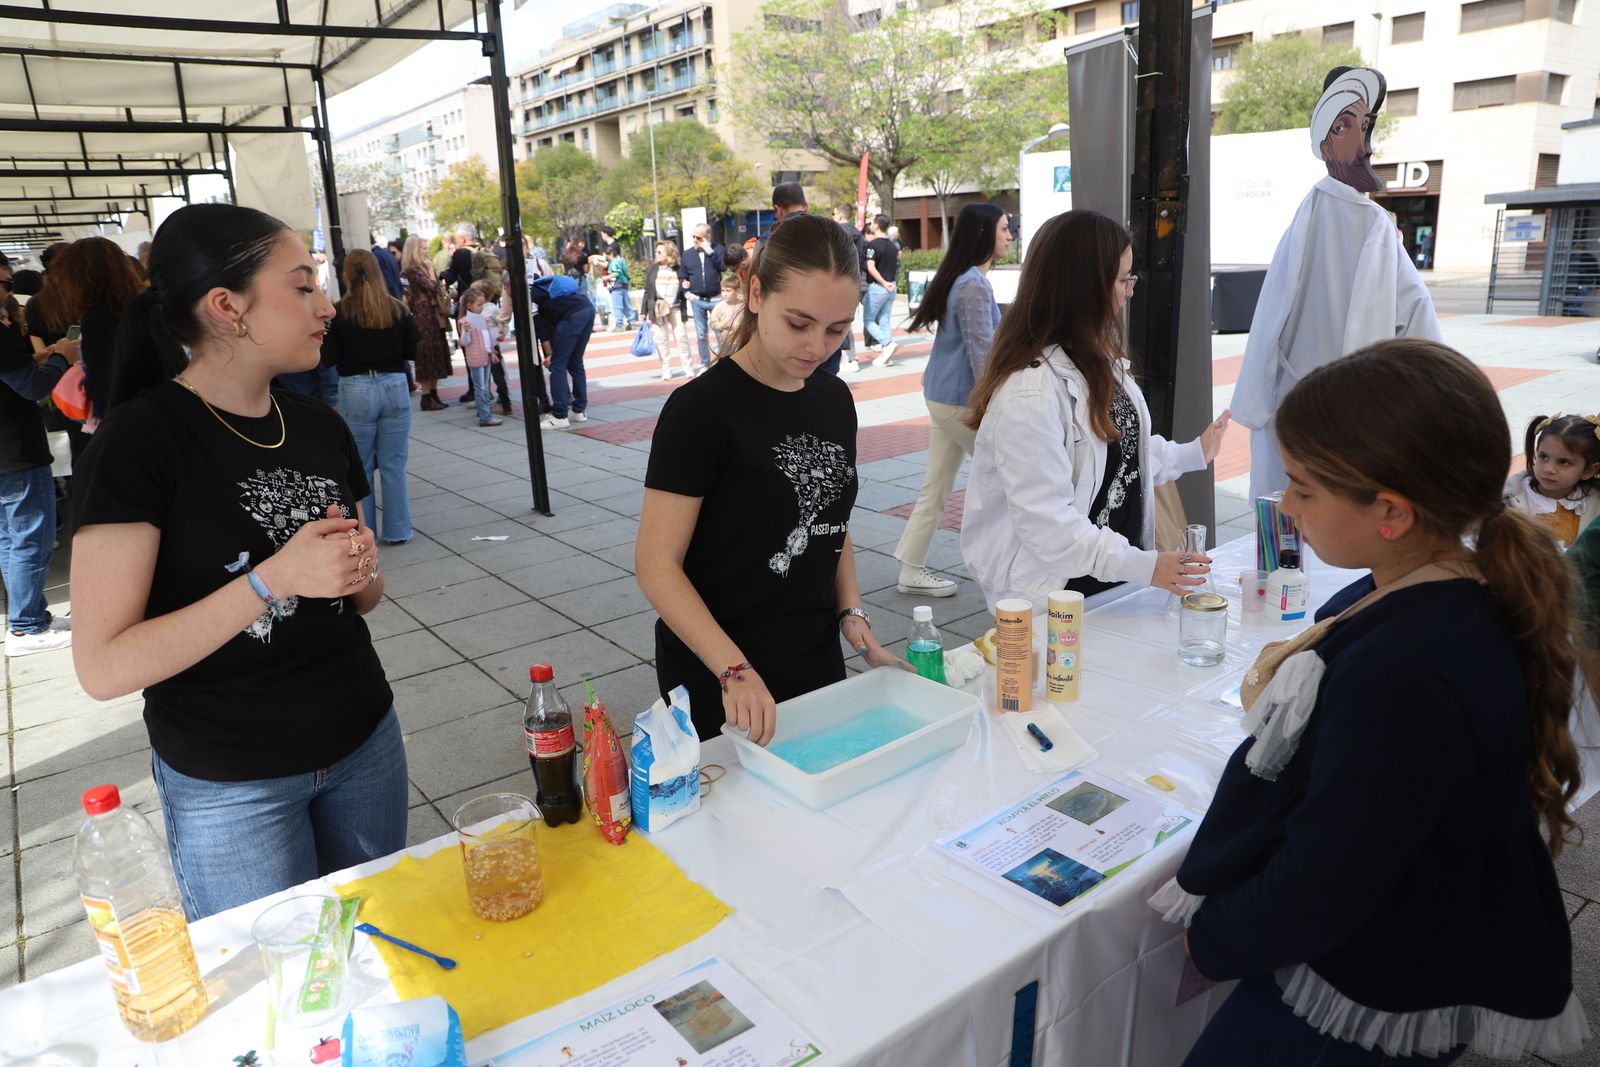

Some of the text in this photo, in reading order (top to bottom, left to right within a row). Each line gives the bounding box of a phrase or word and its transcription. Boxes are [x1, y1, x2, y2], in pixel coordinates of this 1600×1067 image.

[1386, 161, 1430, 188] JD
[811, 523, 829, 536] PASEO
[996, 788, 1060, 825] ROMPER EL HIELO
[579, 994, 656, 1032] MAÍZ LOCO
